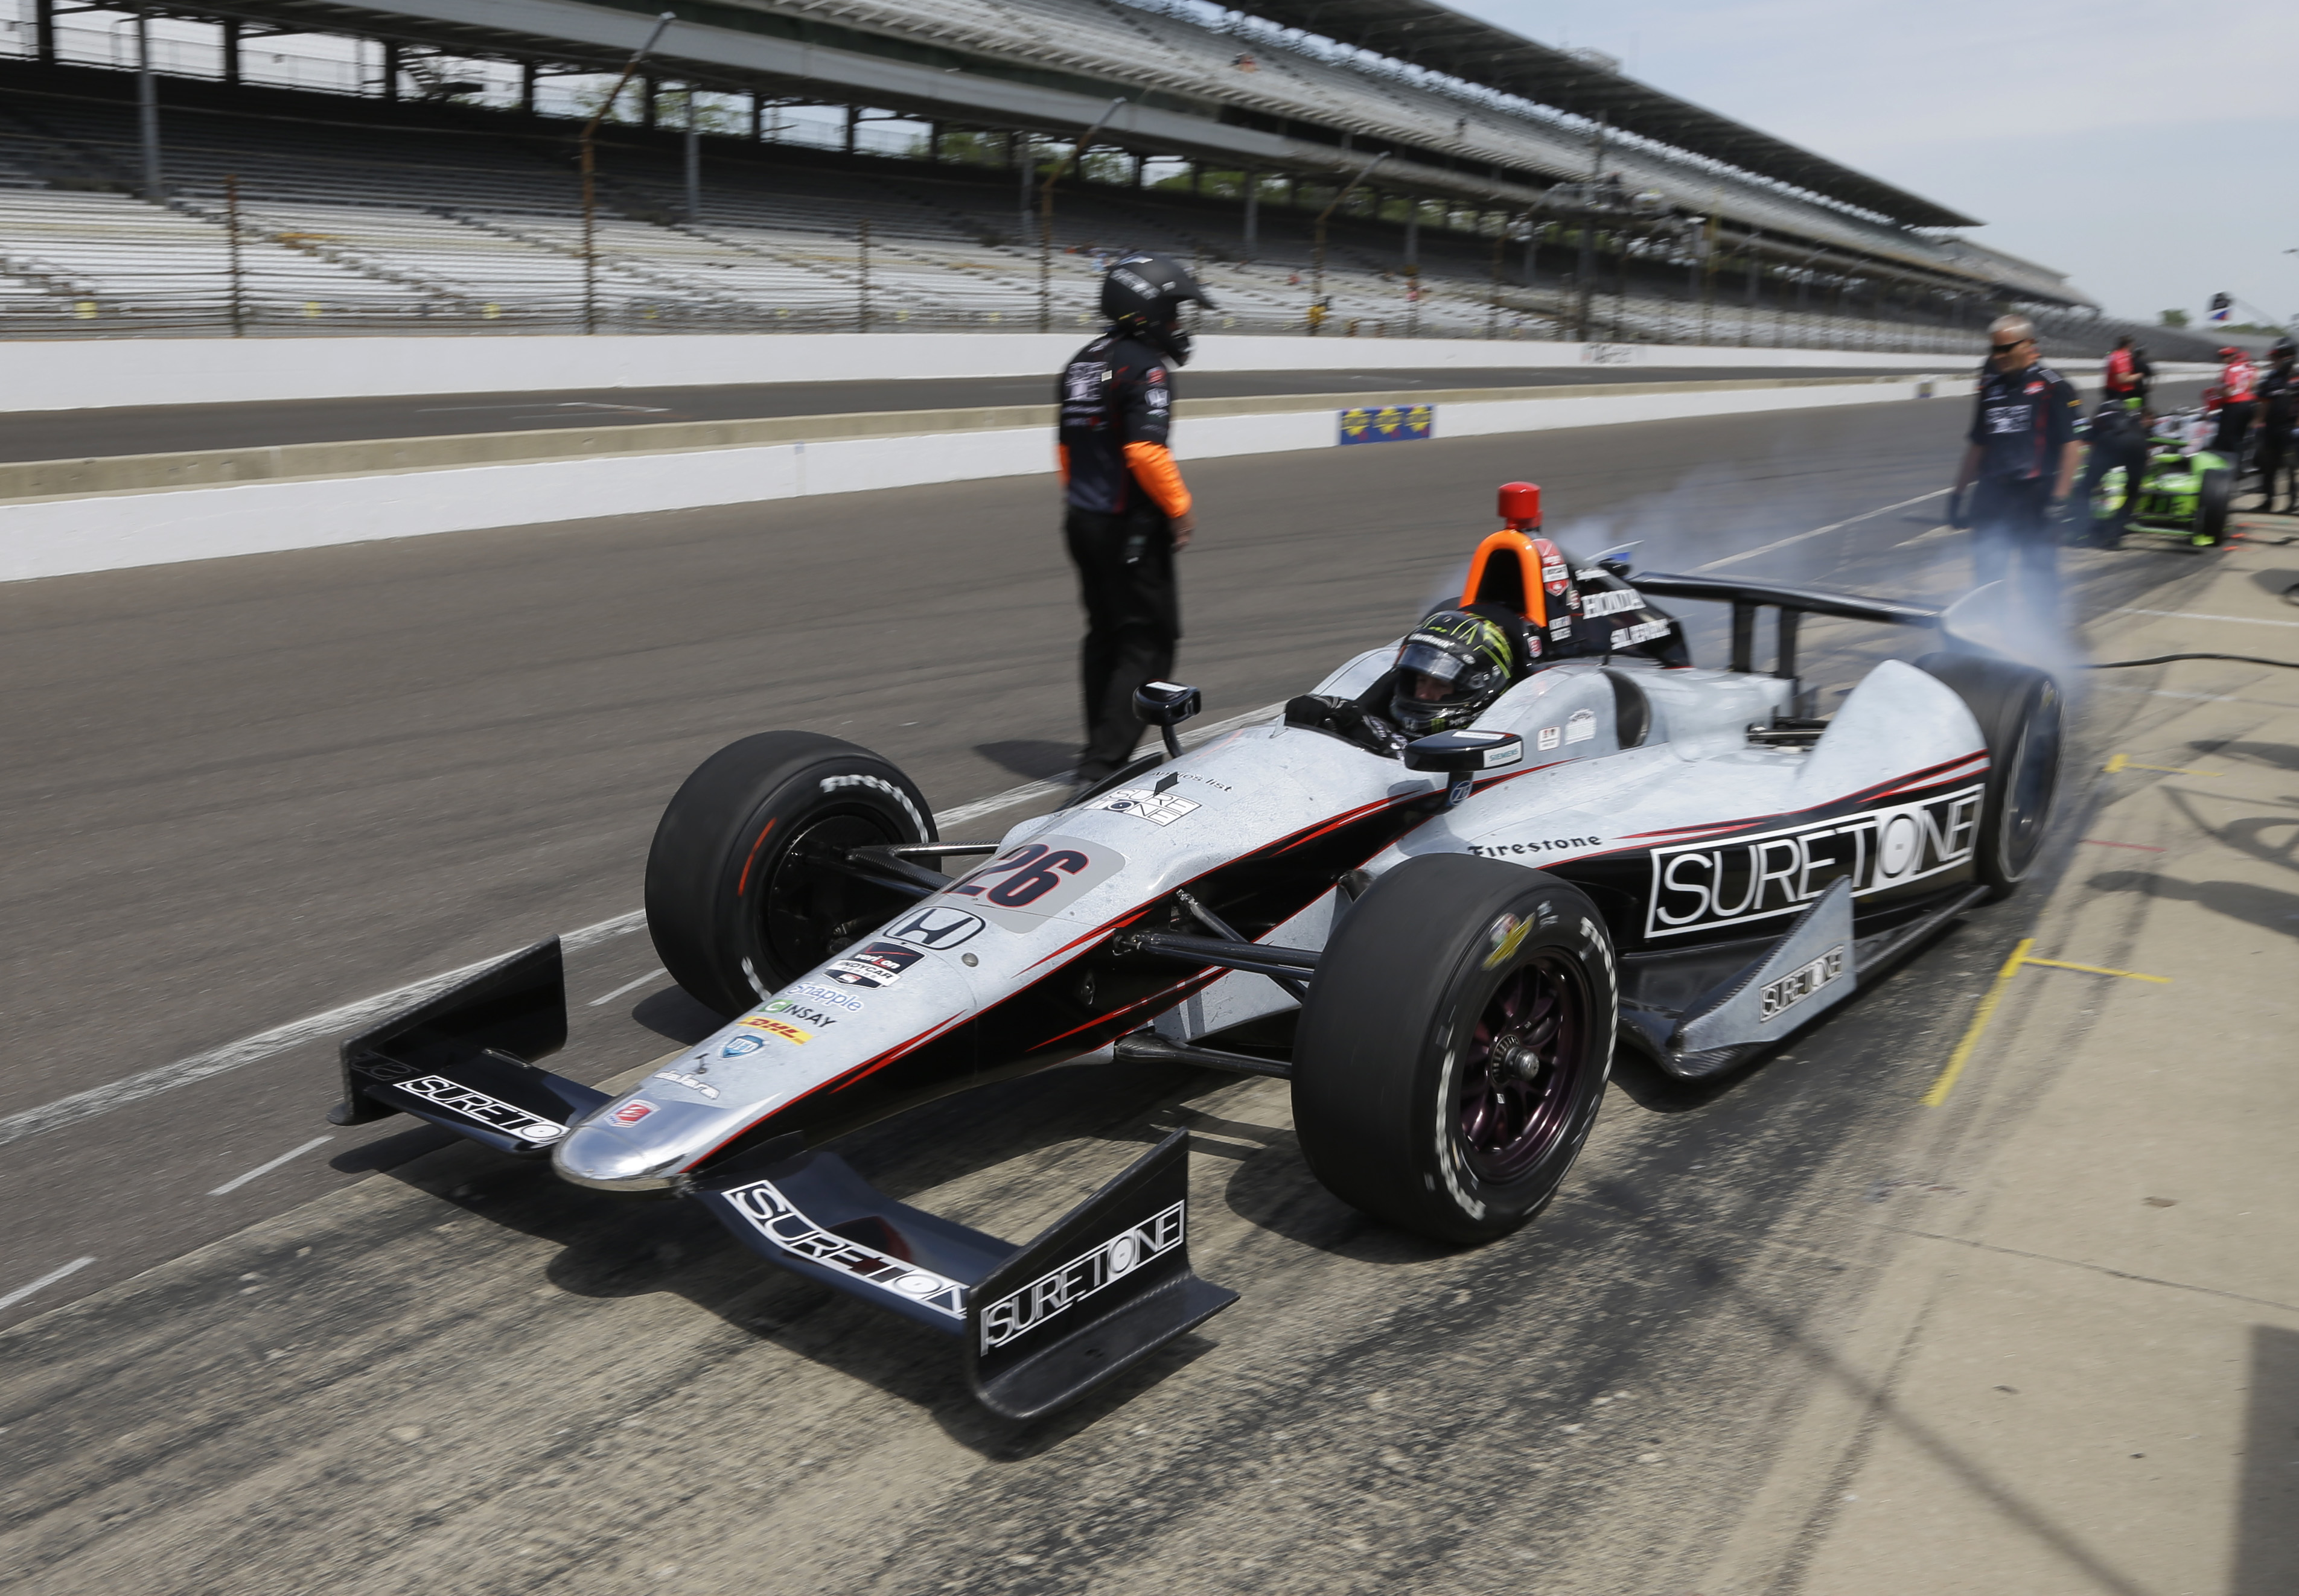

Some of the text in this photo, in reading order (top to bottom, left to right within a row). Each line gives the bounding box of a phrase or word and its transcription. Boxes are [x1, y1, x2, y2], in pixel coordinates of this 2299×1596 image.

[1205, 779, 1233, 792] list
[1467, 836, 1601, 857] Firestone
[1657, 793, 1979, 926] SURETONE
[942, 844, 1091, 908] 26
[853, 953, 901, 970] verizon
[786, 982, 862, 1011] Snapple
[747, 1018, 800, 1038] DHL
[765, 1001, 837, 1028] CINSAY
[653, 1070, 721, 1100] dallara
[405, 1079, 564, 1142] SURETO
[736, 1188, 966, 1318] SURETON
[985, 1207, 1181, 1345] SURETONE
